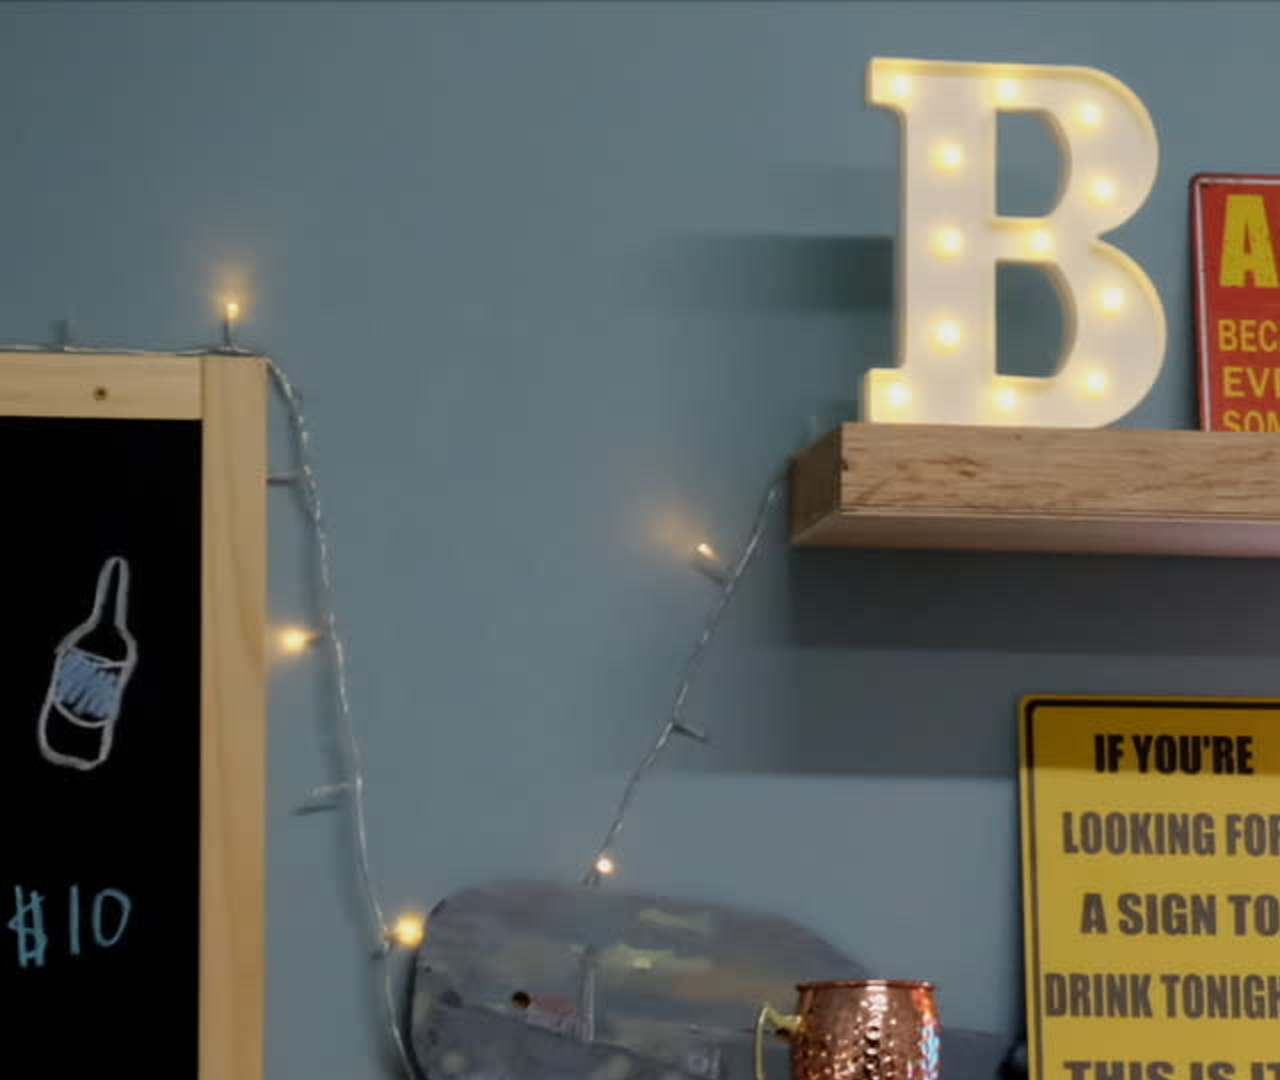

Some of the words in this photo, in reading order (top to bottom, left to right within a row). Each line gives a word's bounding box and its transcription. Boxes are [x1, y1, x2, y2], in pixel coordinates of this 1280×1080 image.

[1093, 733, 1124, 774] IF
[1133, 733, 1255, 775] YOU'RE
[1062, 811, 1216, 856] LOOKING
[8, 883, 132, 967] $10
[1080, 893, 1107, 935] A
[1118, 893, 1217, 936] SIGN
[1228, 894, 1280, 937] TO
[1045, 973, 1153, 1018] DRINK
